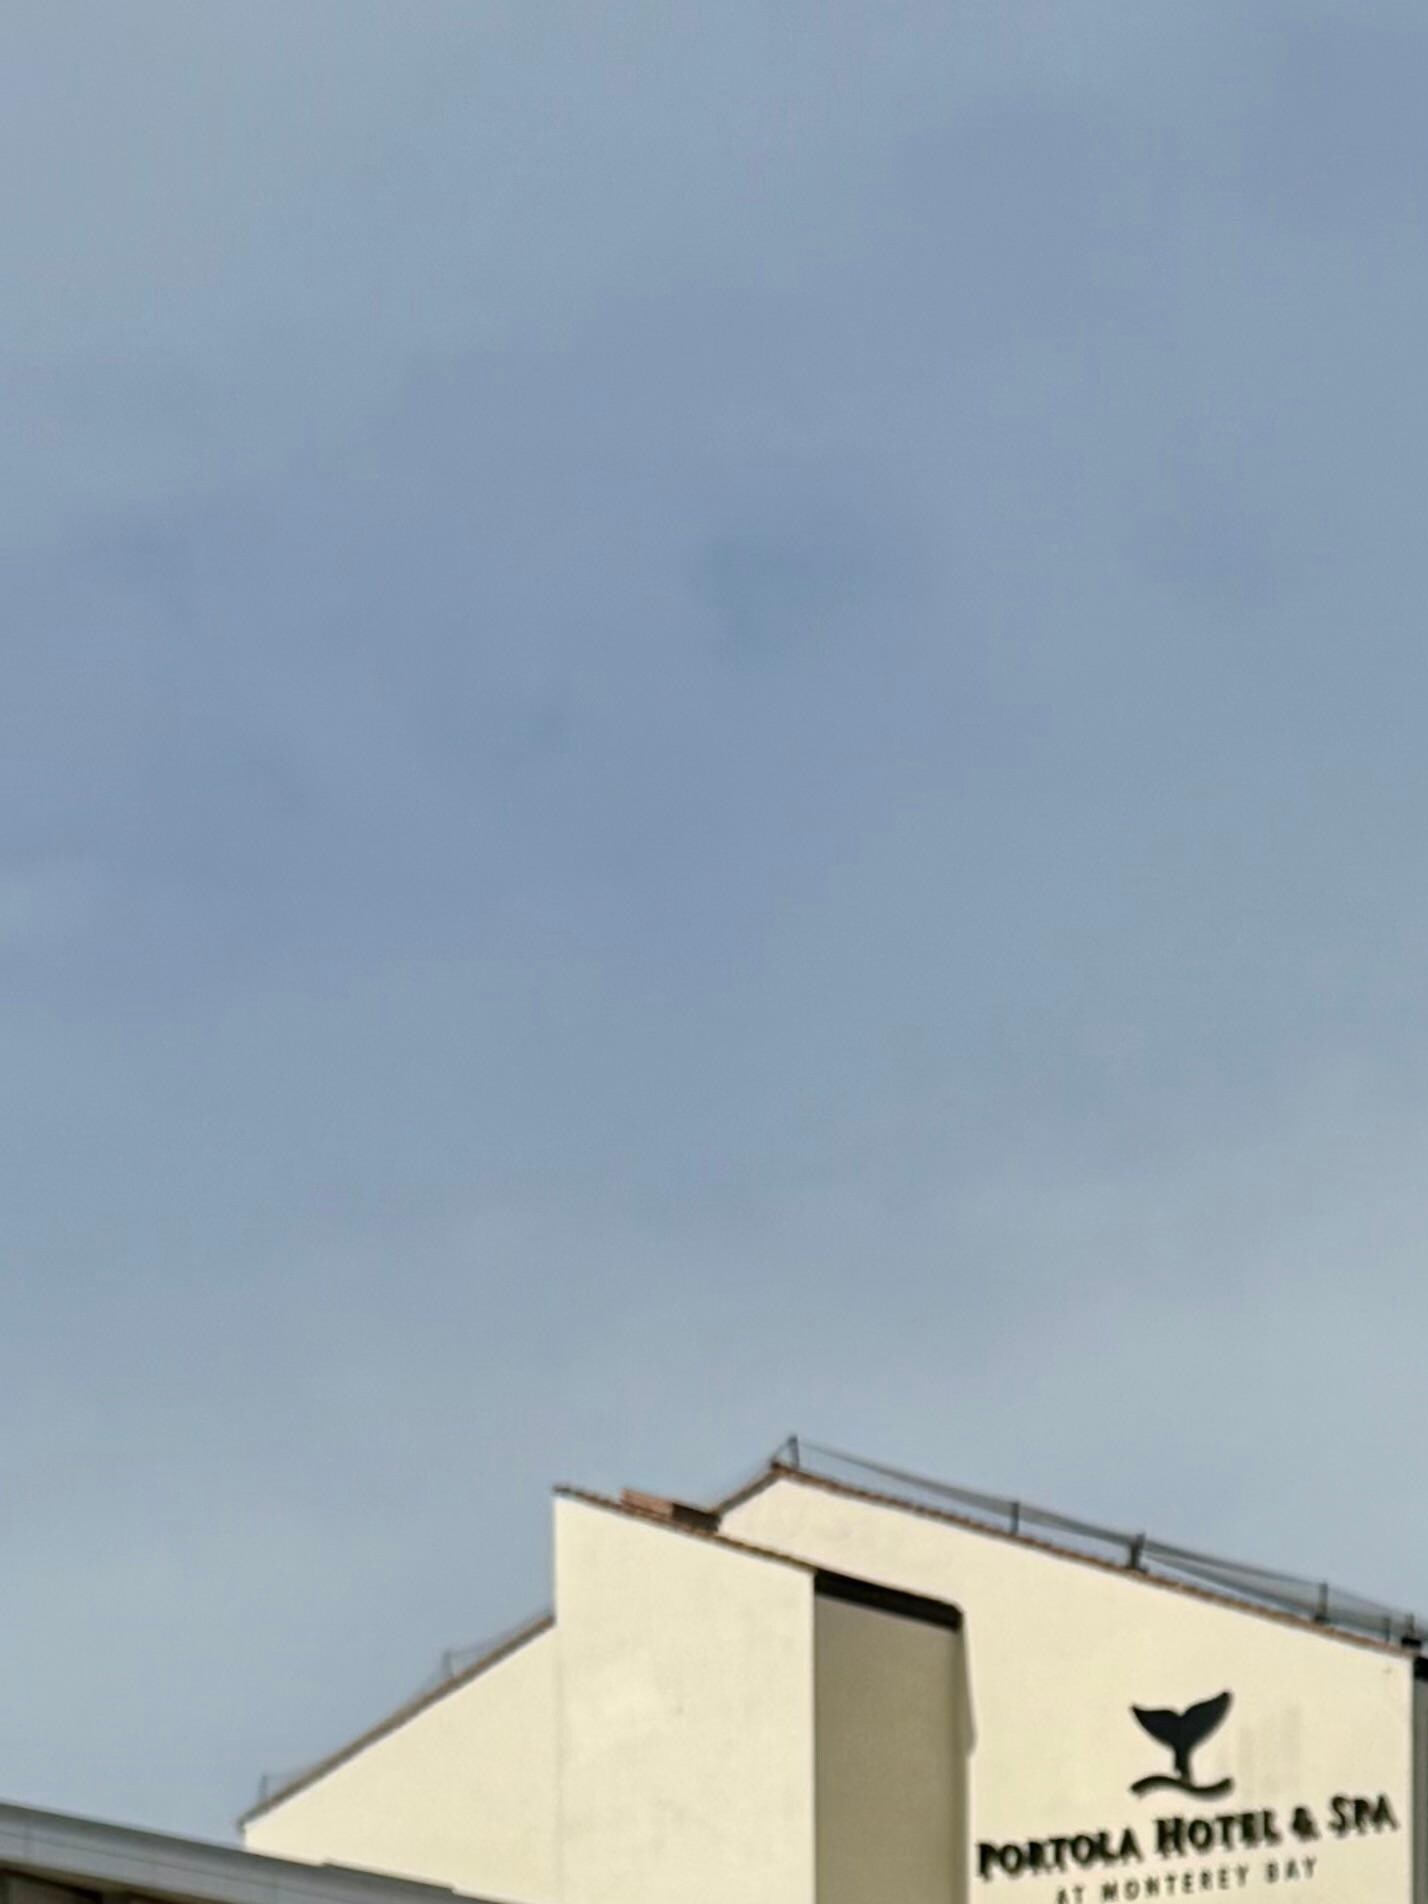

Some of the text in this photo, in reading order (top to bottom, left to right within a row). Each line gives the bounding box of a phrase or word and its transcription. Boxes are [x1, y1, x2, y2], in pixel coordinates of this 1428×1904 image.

[976, 1794, 1398, 1882] PORTOLA HOTEL & SPA
[1102, 1866, 1249, 1902] MONTEREY
[1266, 1857, 1317, 1882] BAY
